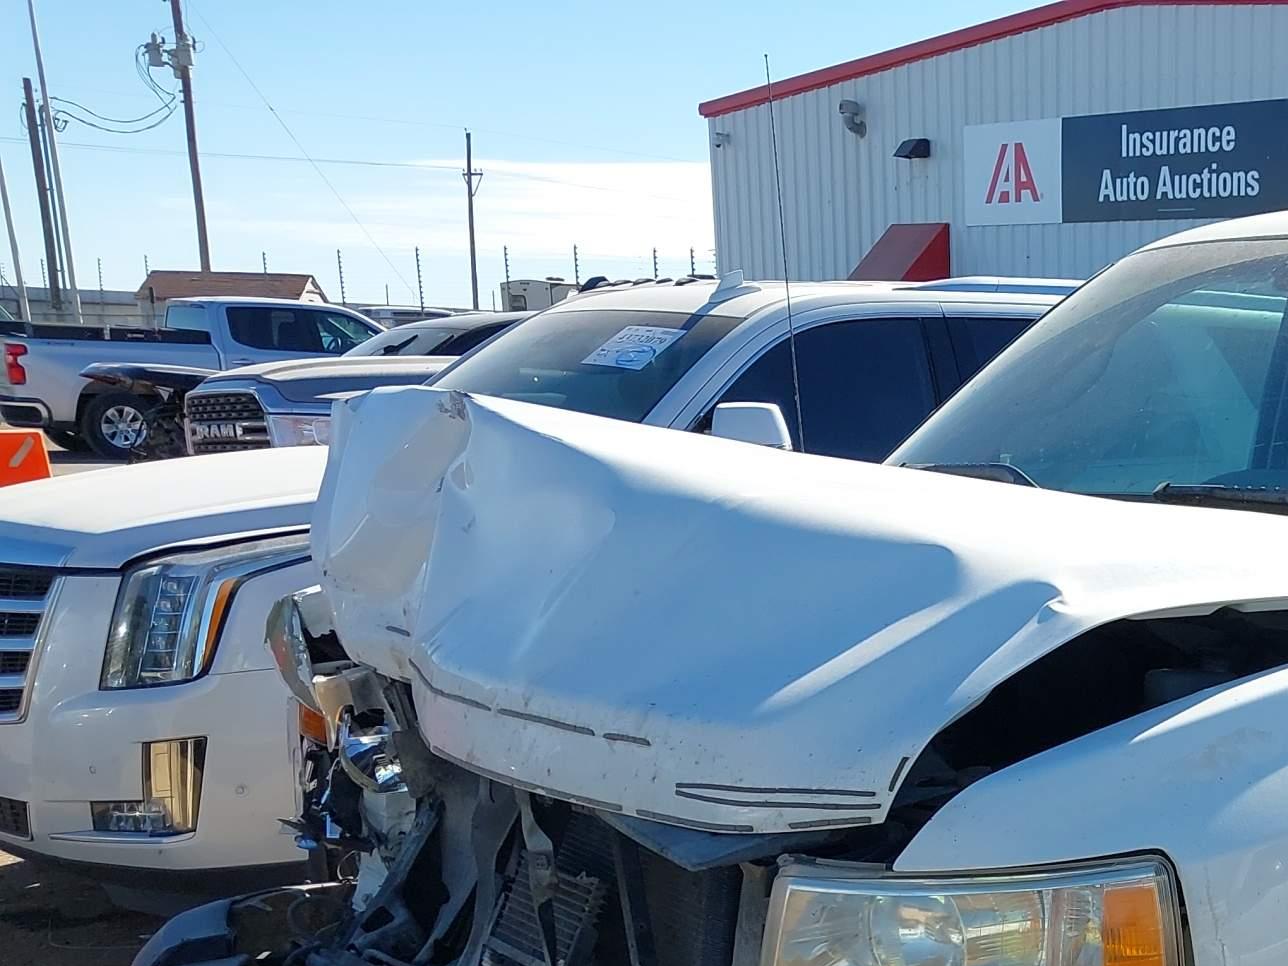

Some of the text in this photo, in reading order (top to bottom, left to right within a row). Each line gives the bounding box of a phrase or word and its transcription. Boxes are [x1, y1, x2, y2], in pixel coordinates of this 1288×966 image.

[1121, 124, 1236, 157] Insurance
[1099, 163, 1260, 202] Auto Auctions
[196, 423, 235, 440] RAM
